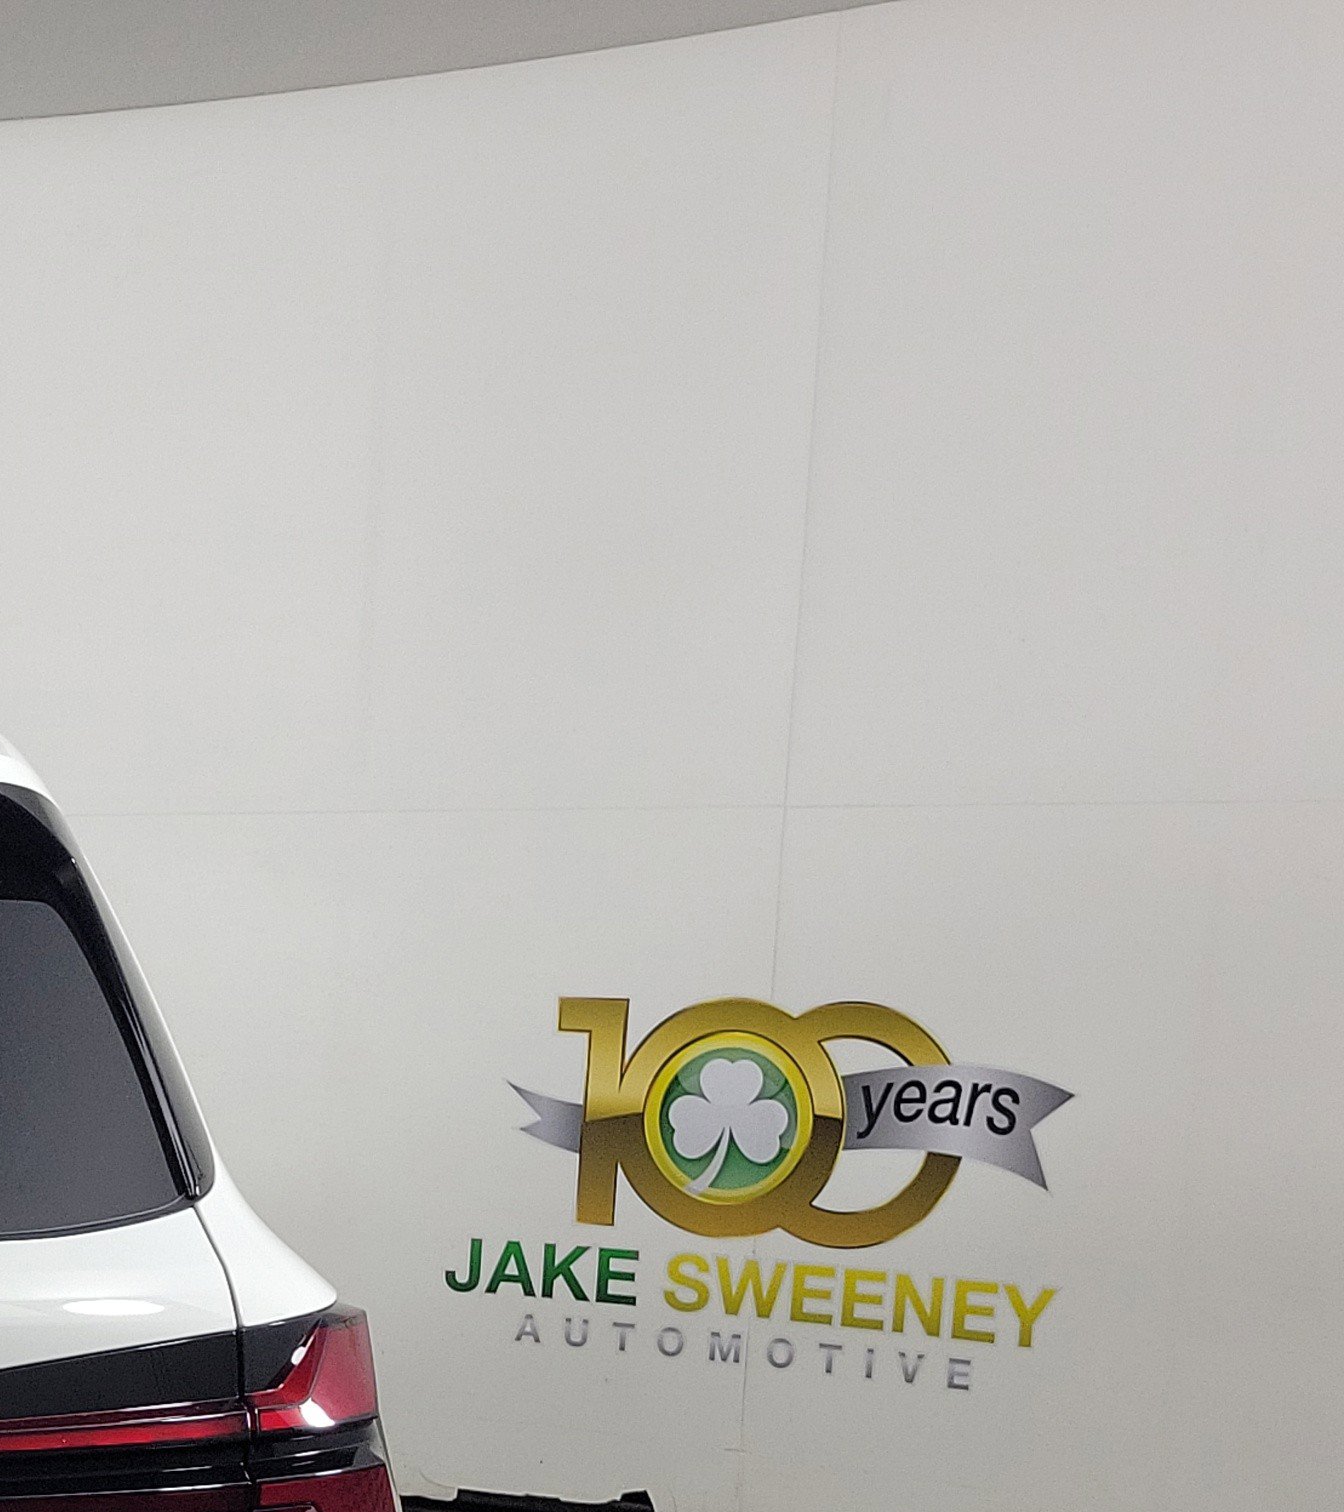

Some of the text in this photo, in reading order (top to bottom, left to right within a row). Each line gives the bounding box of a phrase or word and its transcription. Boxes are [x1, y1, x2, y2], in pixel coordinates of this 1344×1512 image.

[558, 998, 1020, 1249] 100 years
[445, 1238, 1055, 1348] JAKE SWEENEY
[514, 1314, 972, 1391] AUTOMOTIVE
